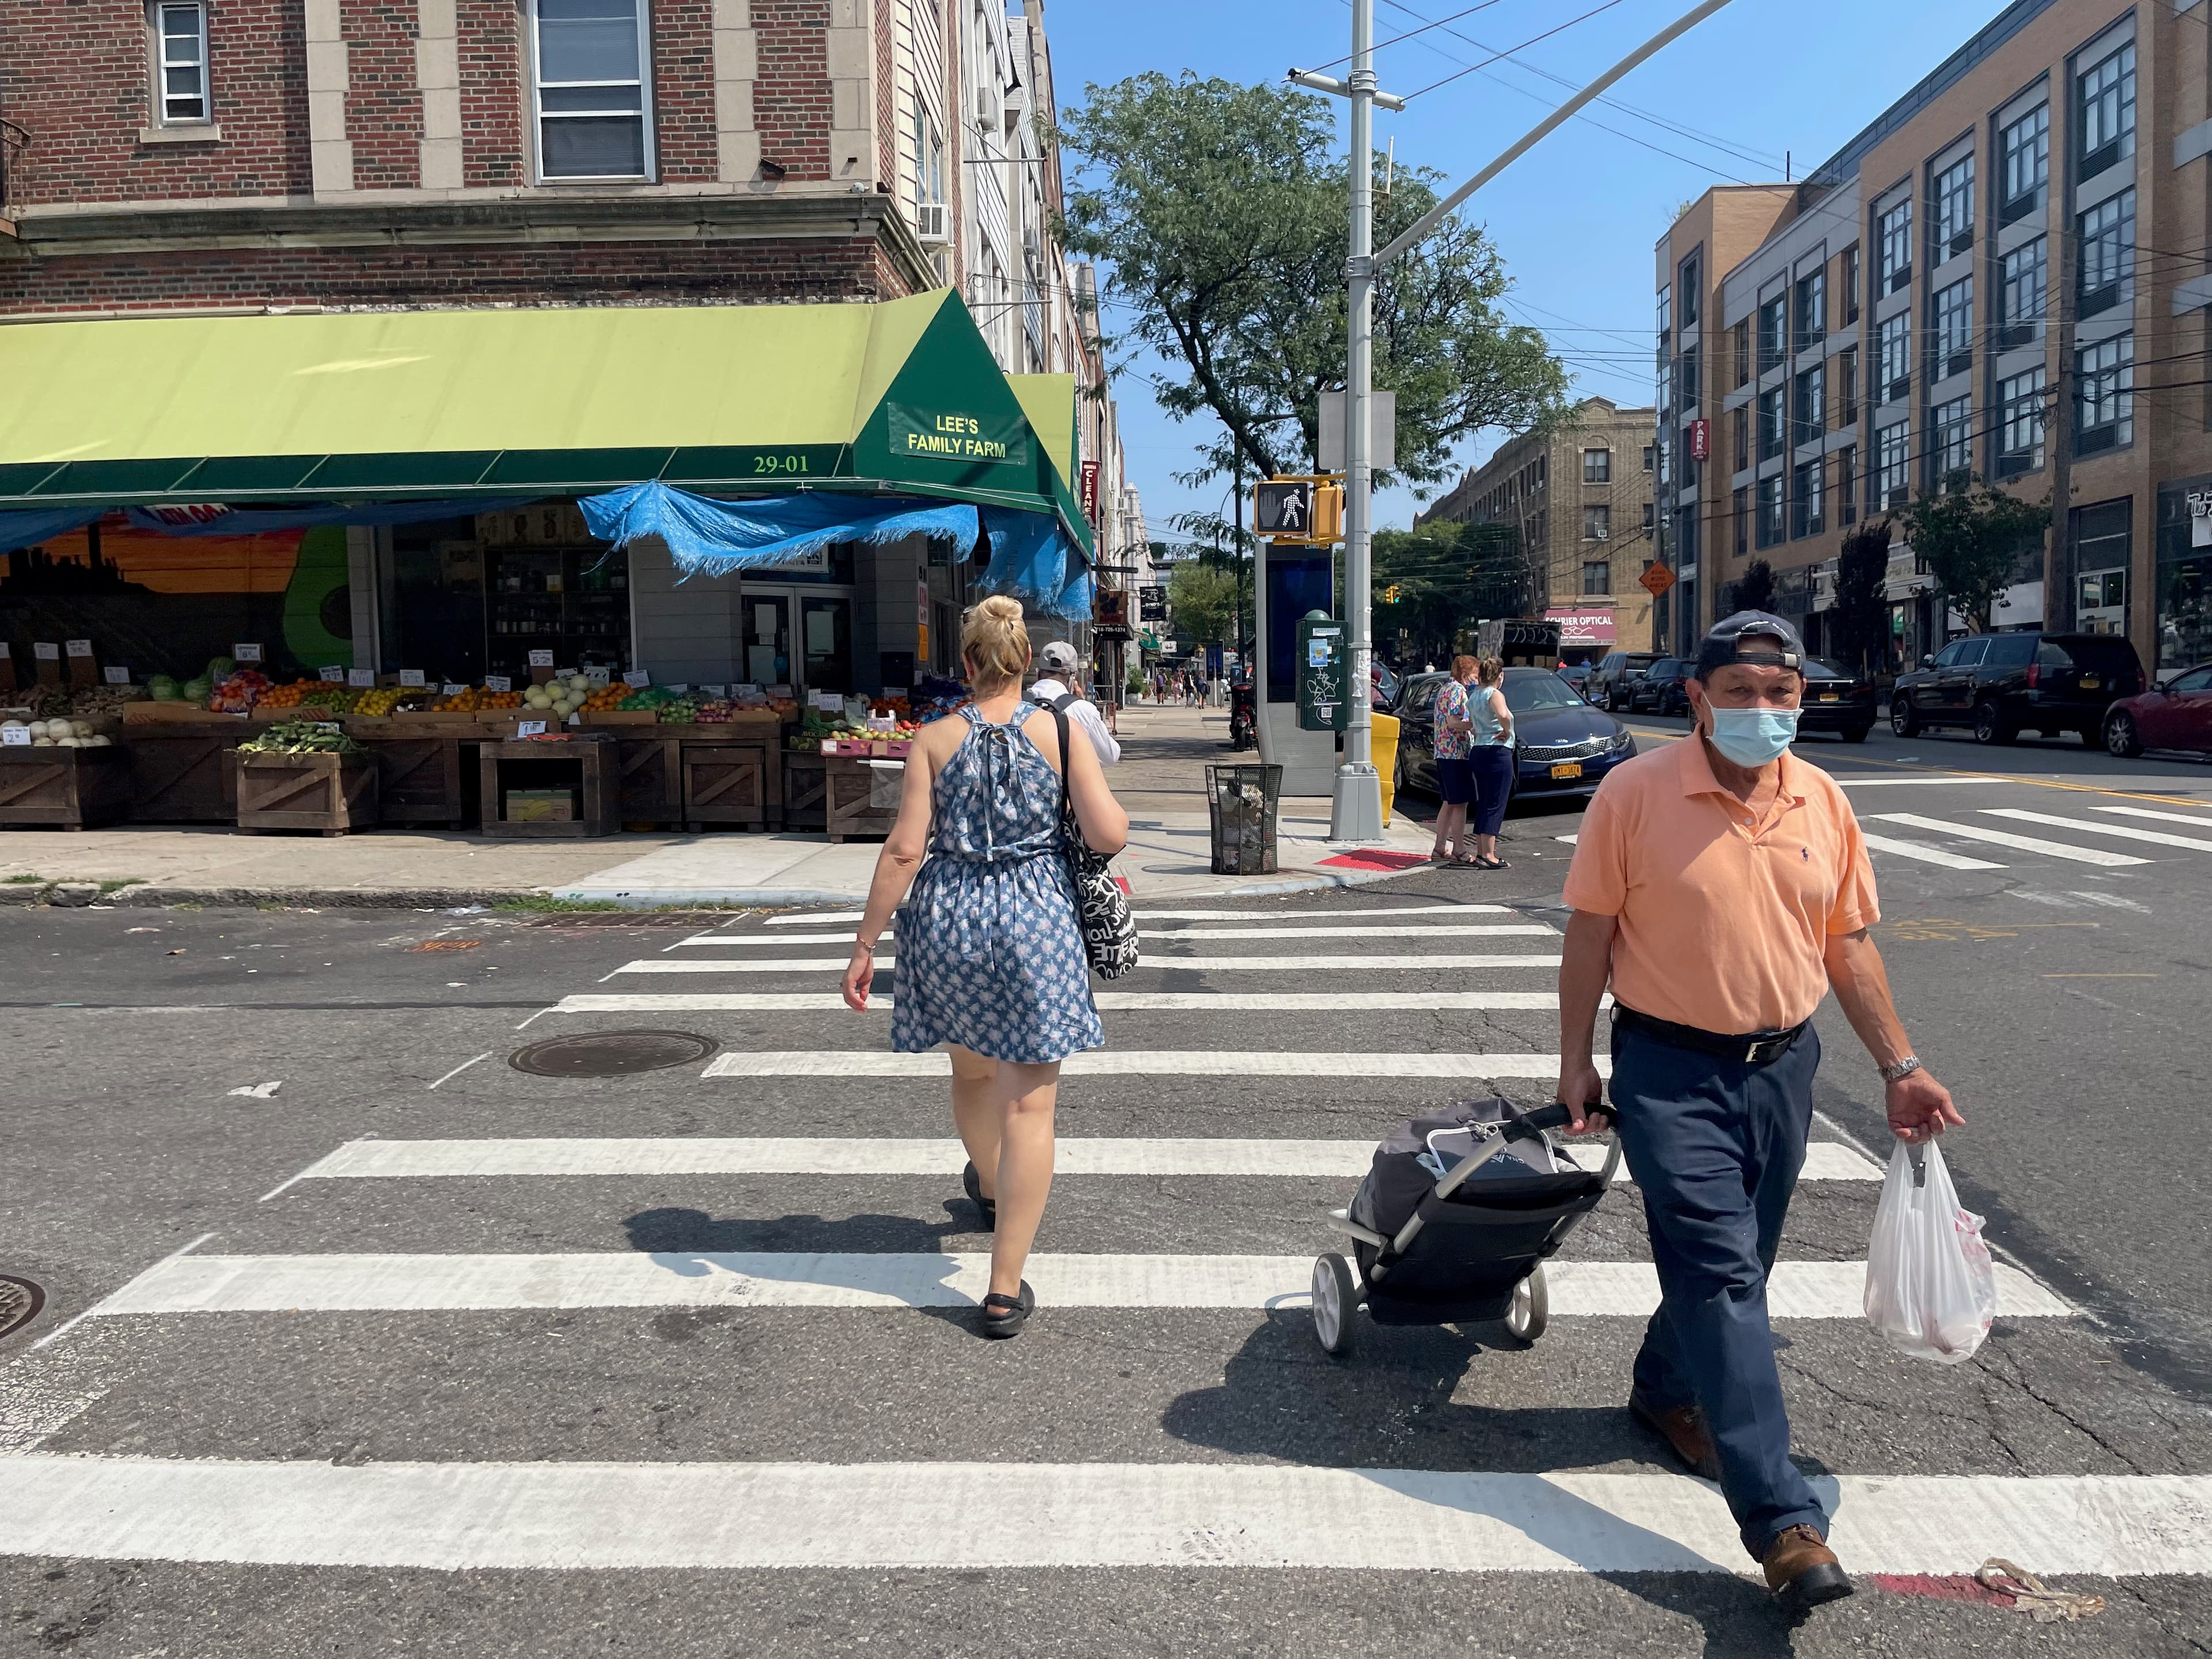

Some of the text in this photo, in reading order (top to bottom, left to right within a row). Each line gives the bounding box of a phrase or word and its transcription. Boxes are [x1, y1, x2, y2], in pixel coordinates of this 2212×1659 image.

[936, 415, 978, 434] LEE'S
[1696, 421, 1705, 450] PARK
[908, 433, 1006, 458] FAMILY FARM
[754, 455, 809, 473] 29-01
[1579, 616, 1613, 626] OPTICAL
